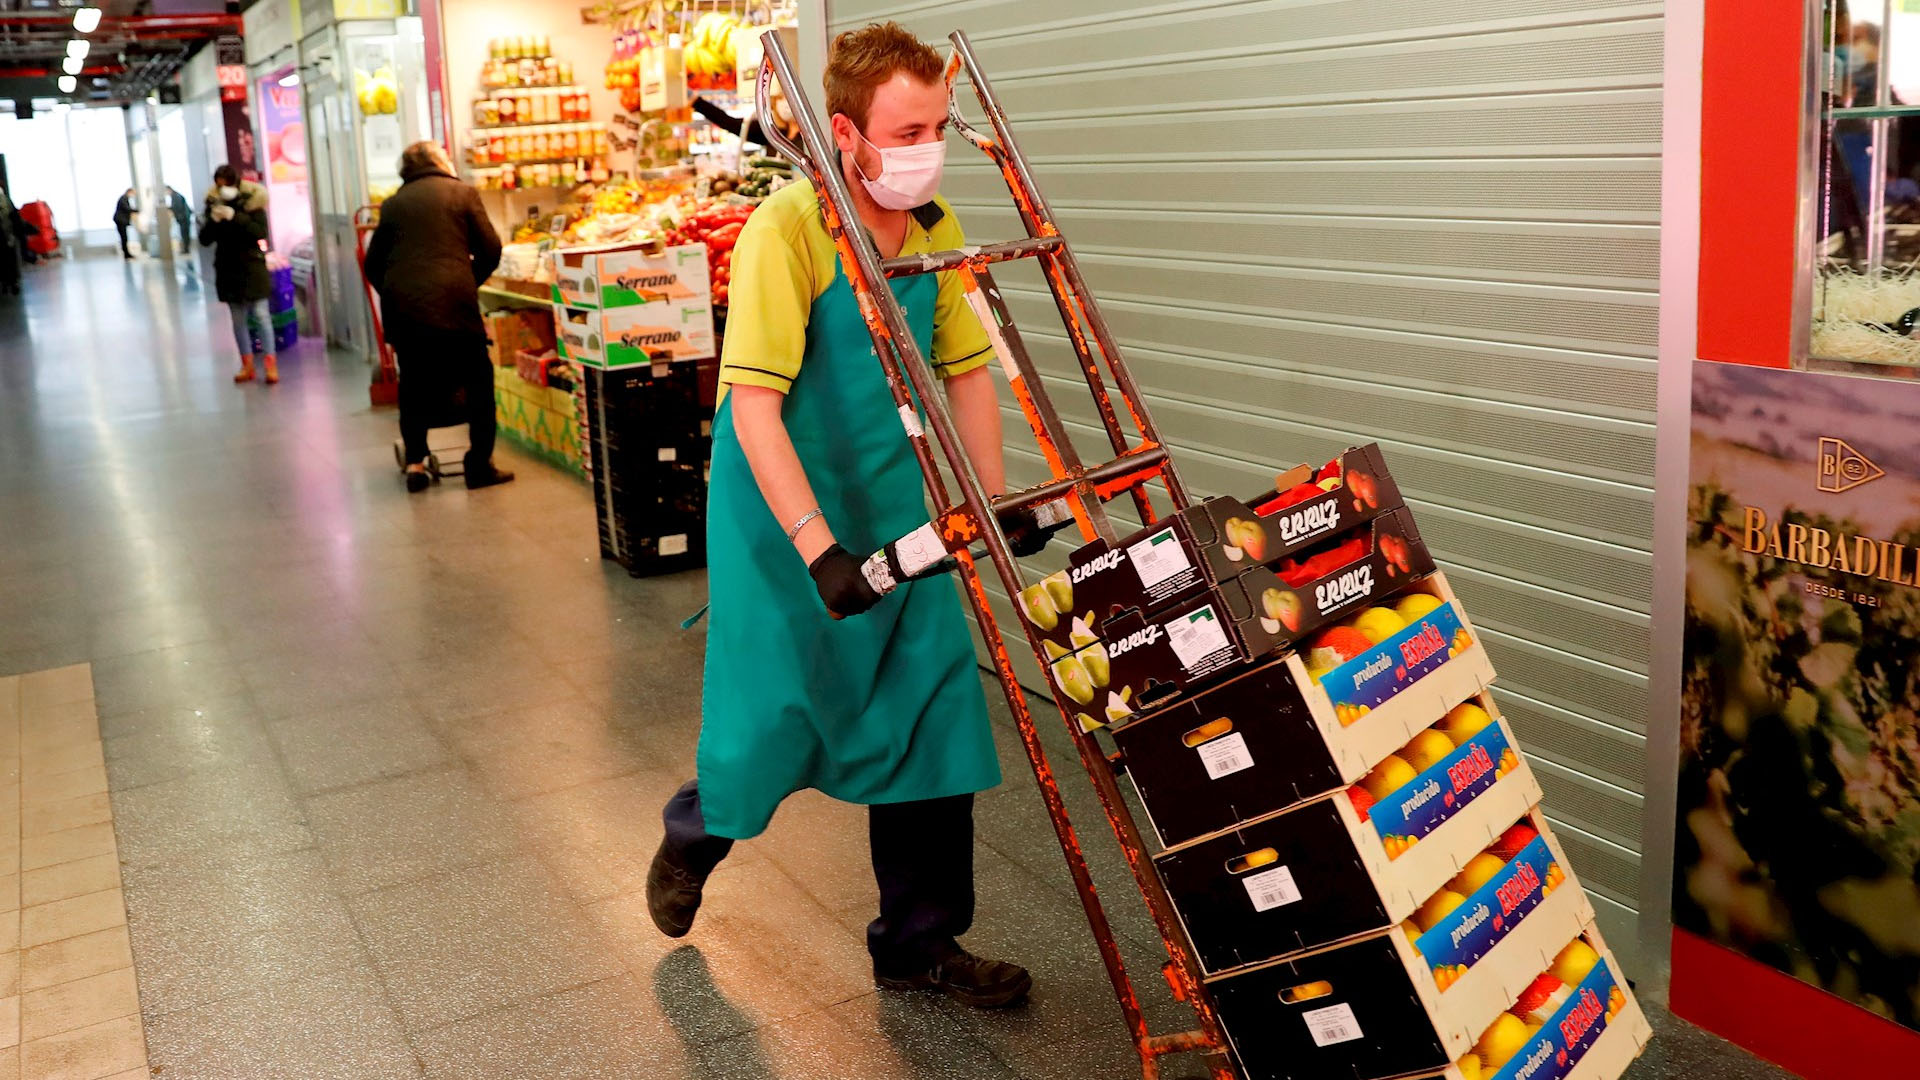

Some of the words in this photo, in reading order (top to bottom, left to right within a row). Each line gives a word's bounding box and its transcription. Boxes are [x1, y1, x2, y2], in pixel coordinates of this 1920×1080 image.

[218, 65, 245, 86] 20
[616, 274, 677, 291] Serrano
[621, 331, 682, 348] Serrano
[1823, 454, 1835, 476] B
[1279, 498, 1341, 541] ERRUZ
[1072, 548, 1126, 584] ERRUZ
[1743, 506, 1920, 588] BARBADIL
[1315, 565, 1375, 610] ERRUZ
[1806, 582, 1846, 601] DESDE
[1853, 593, 1881, 608] 1821
[1108, 624, 1164, 658] ERRUZ
[1352, 652, 1393, 690] producido
[1399, 621, 1447, 670] ESPAÑA
[1400, 778, 1441, 821] producido
[1447, 742, 1494, 795] ESPAÑA
[1450, 902, 1490, 949] producido
[1495, 860, 1540, 918] ESPAÑA
[1559, 987, 1604, 1051] ESPAÑA
